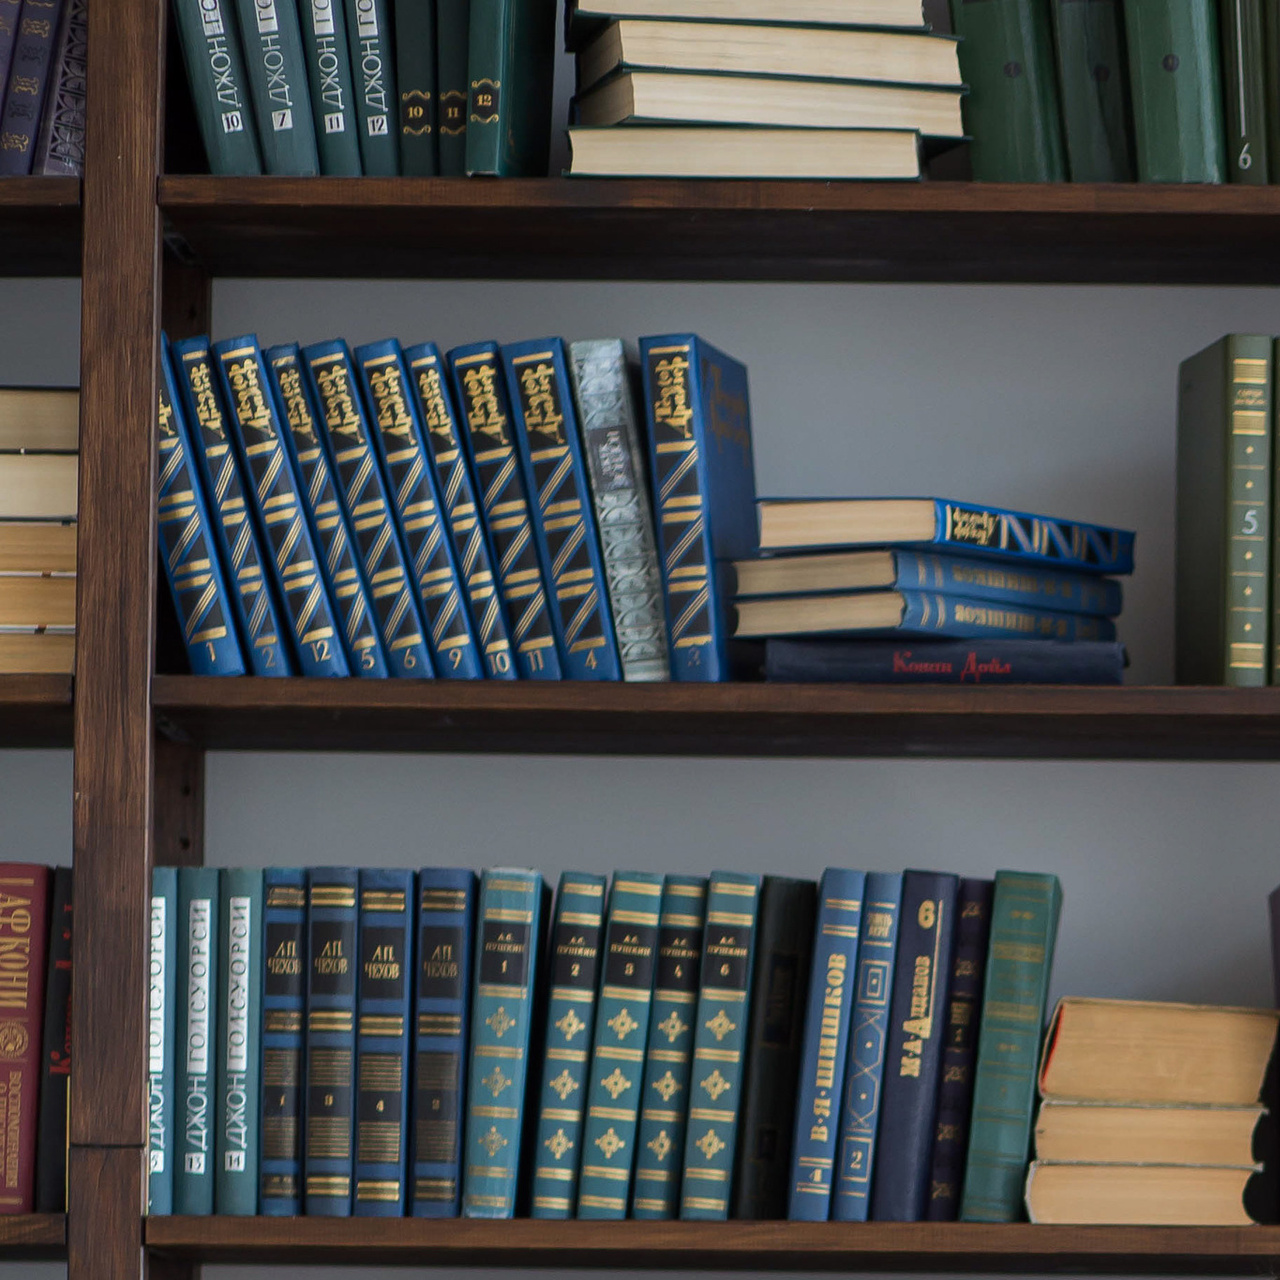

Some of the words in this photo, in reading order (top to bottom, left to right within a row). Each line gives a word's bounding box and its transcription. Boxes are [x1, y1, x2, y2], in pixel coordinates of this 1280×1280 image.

[207, 36, 242, 109] ДЖОН
[261, 34, 292, 107] ДЖОН
[316, 37, 344, 110] ДЖОН
[360, 38, 388, 112] ДЖОН
[477, 94, 492, 107] 12
[224, 112, 241, 129] 10
[278, 112, 287, 127] 7
[328, 115, 342, 130] 11
[371, 119, 385, 132] 12
[1238, 143, 1252, 170] 6
[1242, 510, 1258, 535] 5
[309, 640, 331, 662] 12
[361, 649, 376, 670] 5
[449, 649, 461, 669] 9
[584, 649, 598, 668] 4
[918, 901, 935, 929] 6
[484, 941, 525, 954] ПУШКИН
[557, 945, 597, 958] ПУШКИН
[314, 956, 348, 974] ЧЕХОВ
[364, 962, 399, 979] ЧЕХОВ
[501, 961, 508, 974] 1
[570, 963, 580, 978] 2
[186, 1073, 207, 1150] ДЖОН
[225, 1073, 247, 1149] ДЖОН
[188, 1155, 202, 1170] 13
[229, 1154, 242, 1169] 14
